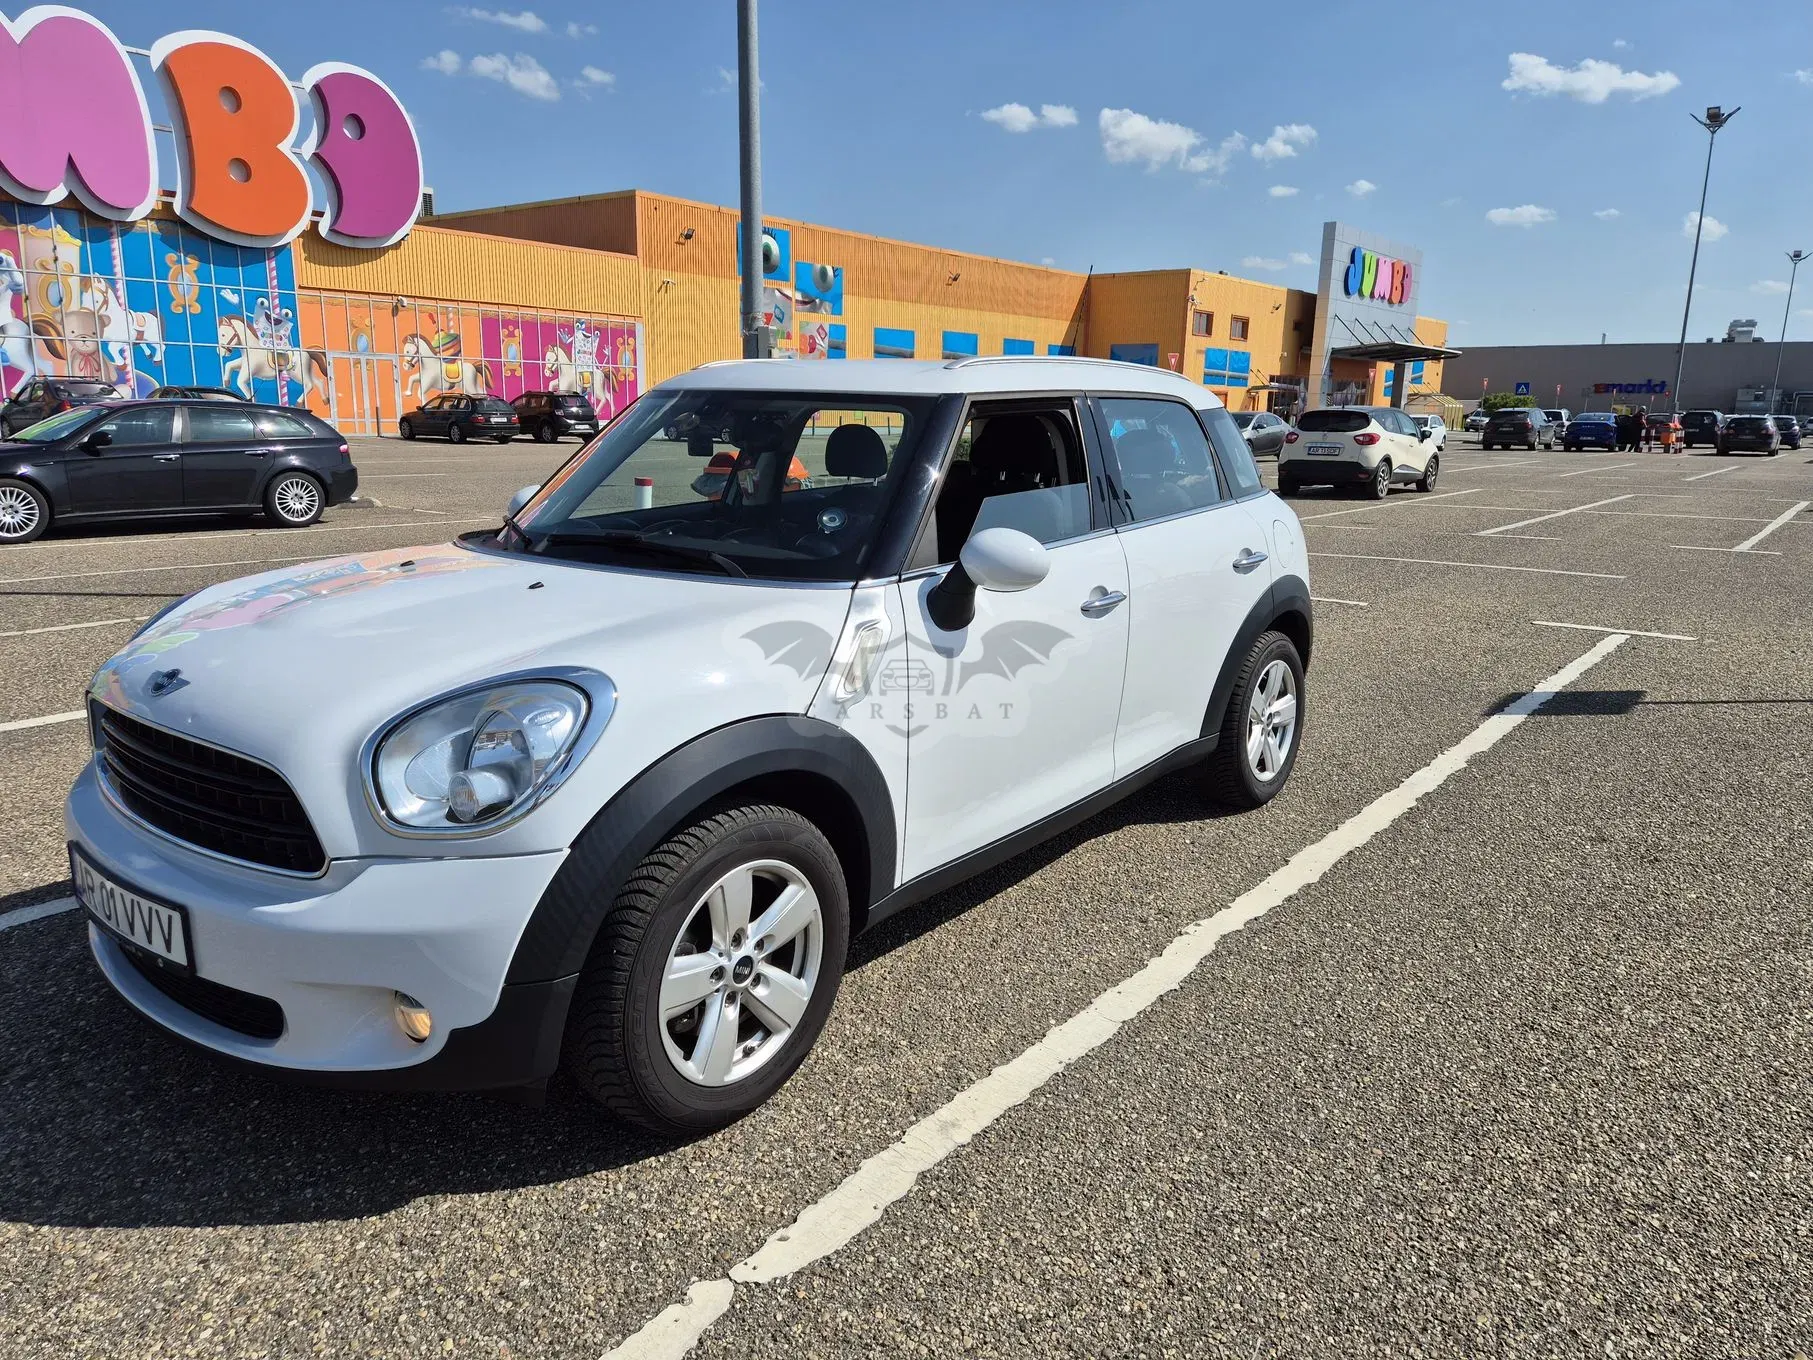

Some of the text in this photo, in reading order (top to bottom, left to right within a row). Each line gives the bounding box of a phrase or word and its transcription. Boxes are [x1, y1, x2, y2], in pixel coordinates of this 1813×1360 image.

[1344, 246, 1413, 304] JUMBO
[101, 881, 120, 929] 01
[120, 892, 173, 954] VVV
